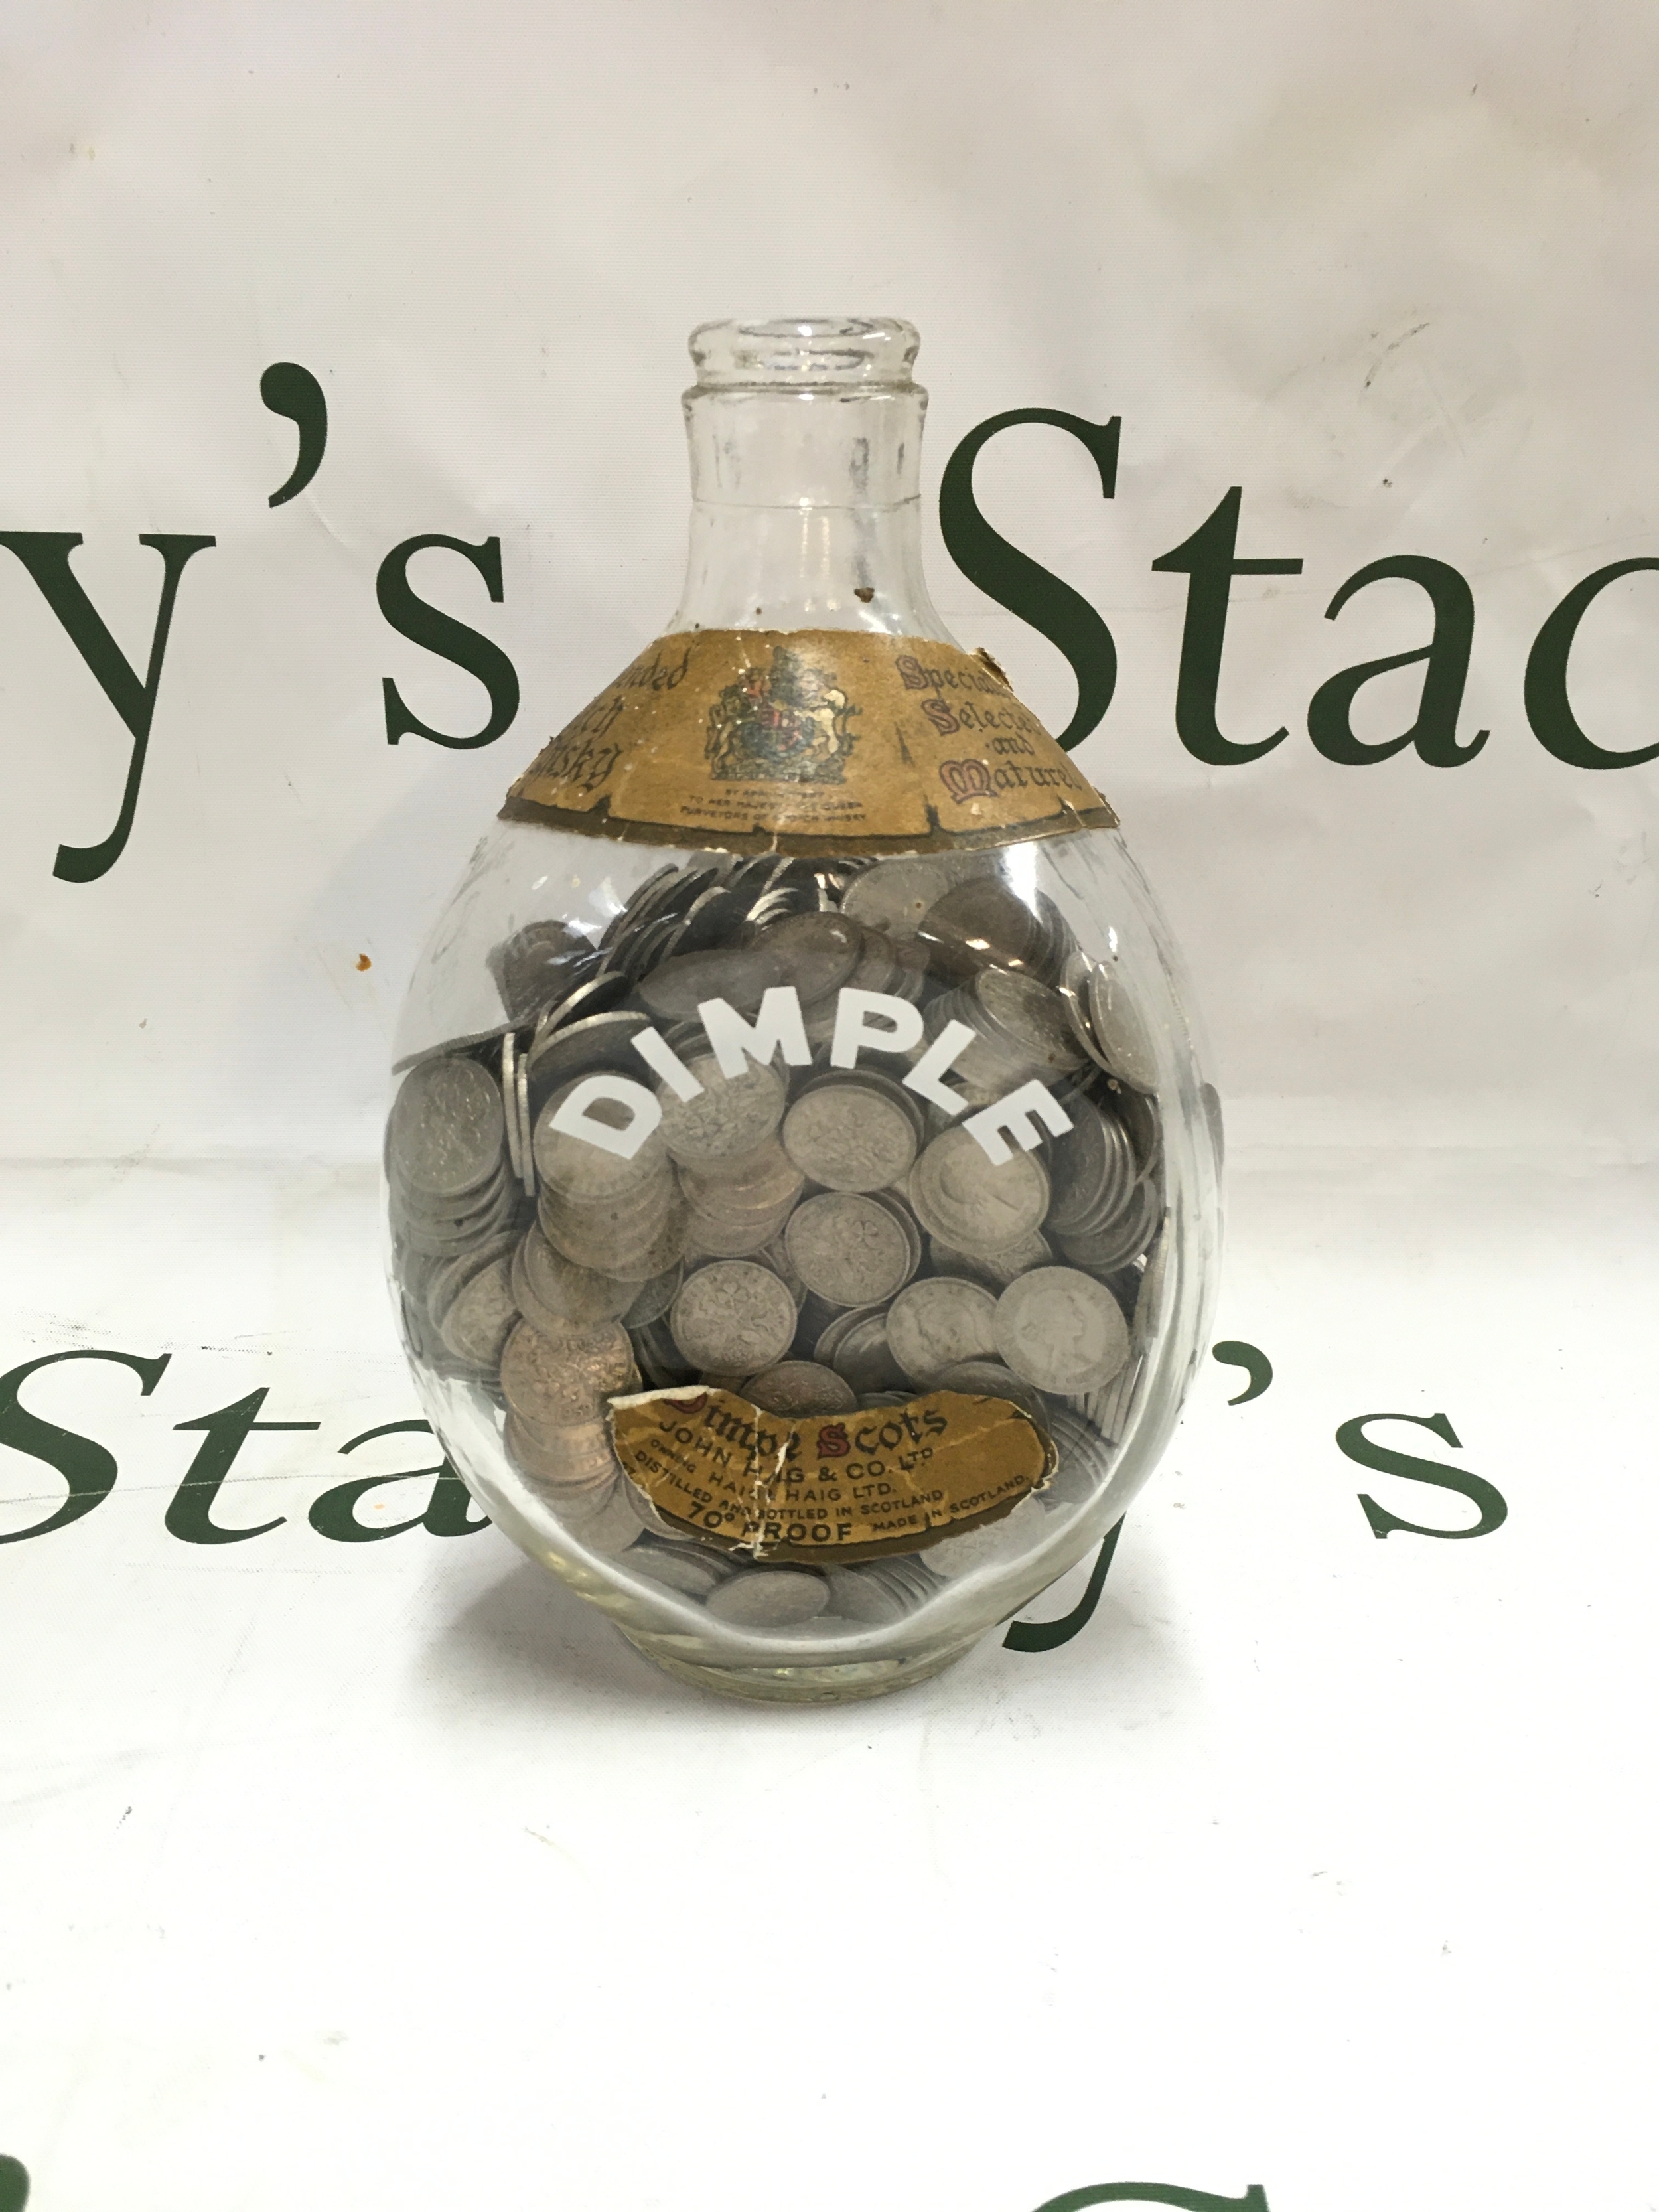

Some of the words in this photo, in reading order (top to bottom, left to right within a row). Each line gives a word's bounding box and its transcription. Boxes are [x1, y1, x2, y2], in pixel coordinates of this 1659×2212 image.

[991, 731, 1036, 756] and
[549, 986, 1075, 1167] DIMPLE
[658, 1420, 733, 1469] JOHN
[818, 1466, 837, 1482] &
[816, 1410, 948, 1460] Scots
[634, 1449, 713, 1503] DISTILLED
[835, 1507, 853, 1518] IN
[861, 1489, 944, 1516] SCOTLAND
[786, 1489, 842, 1502] HAIG
[740, 1519, 853, 1543] PROOF
